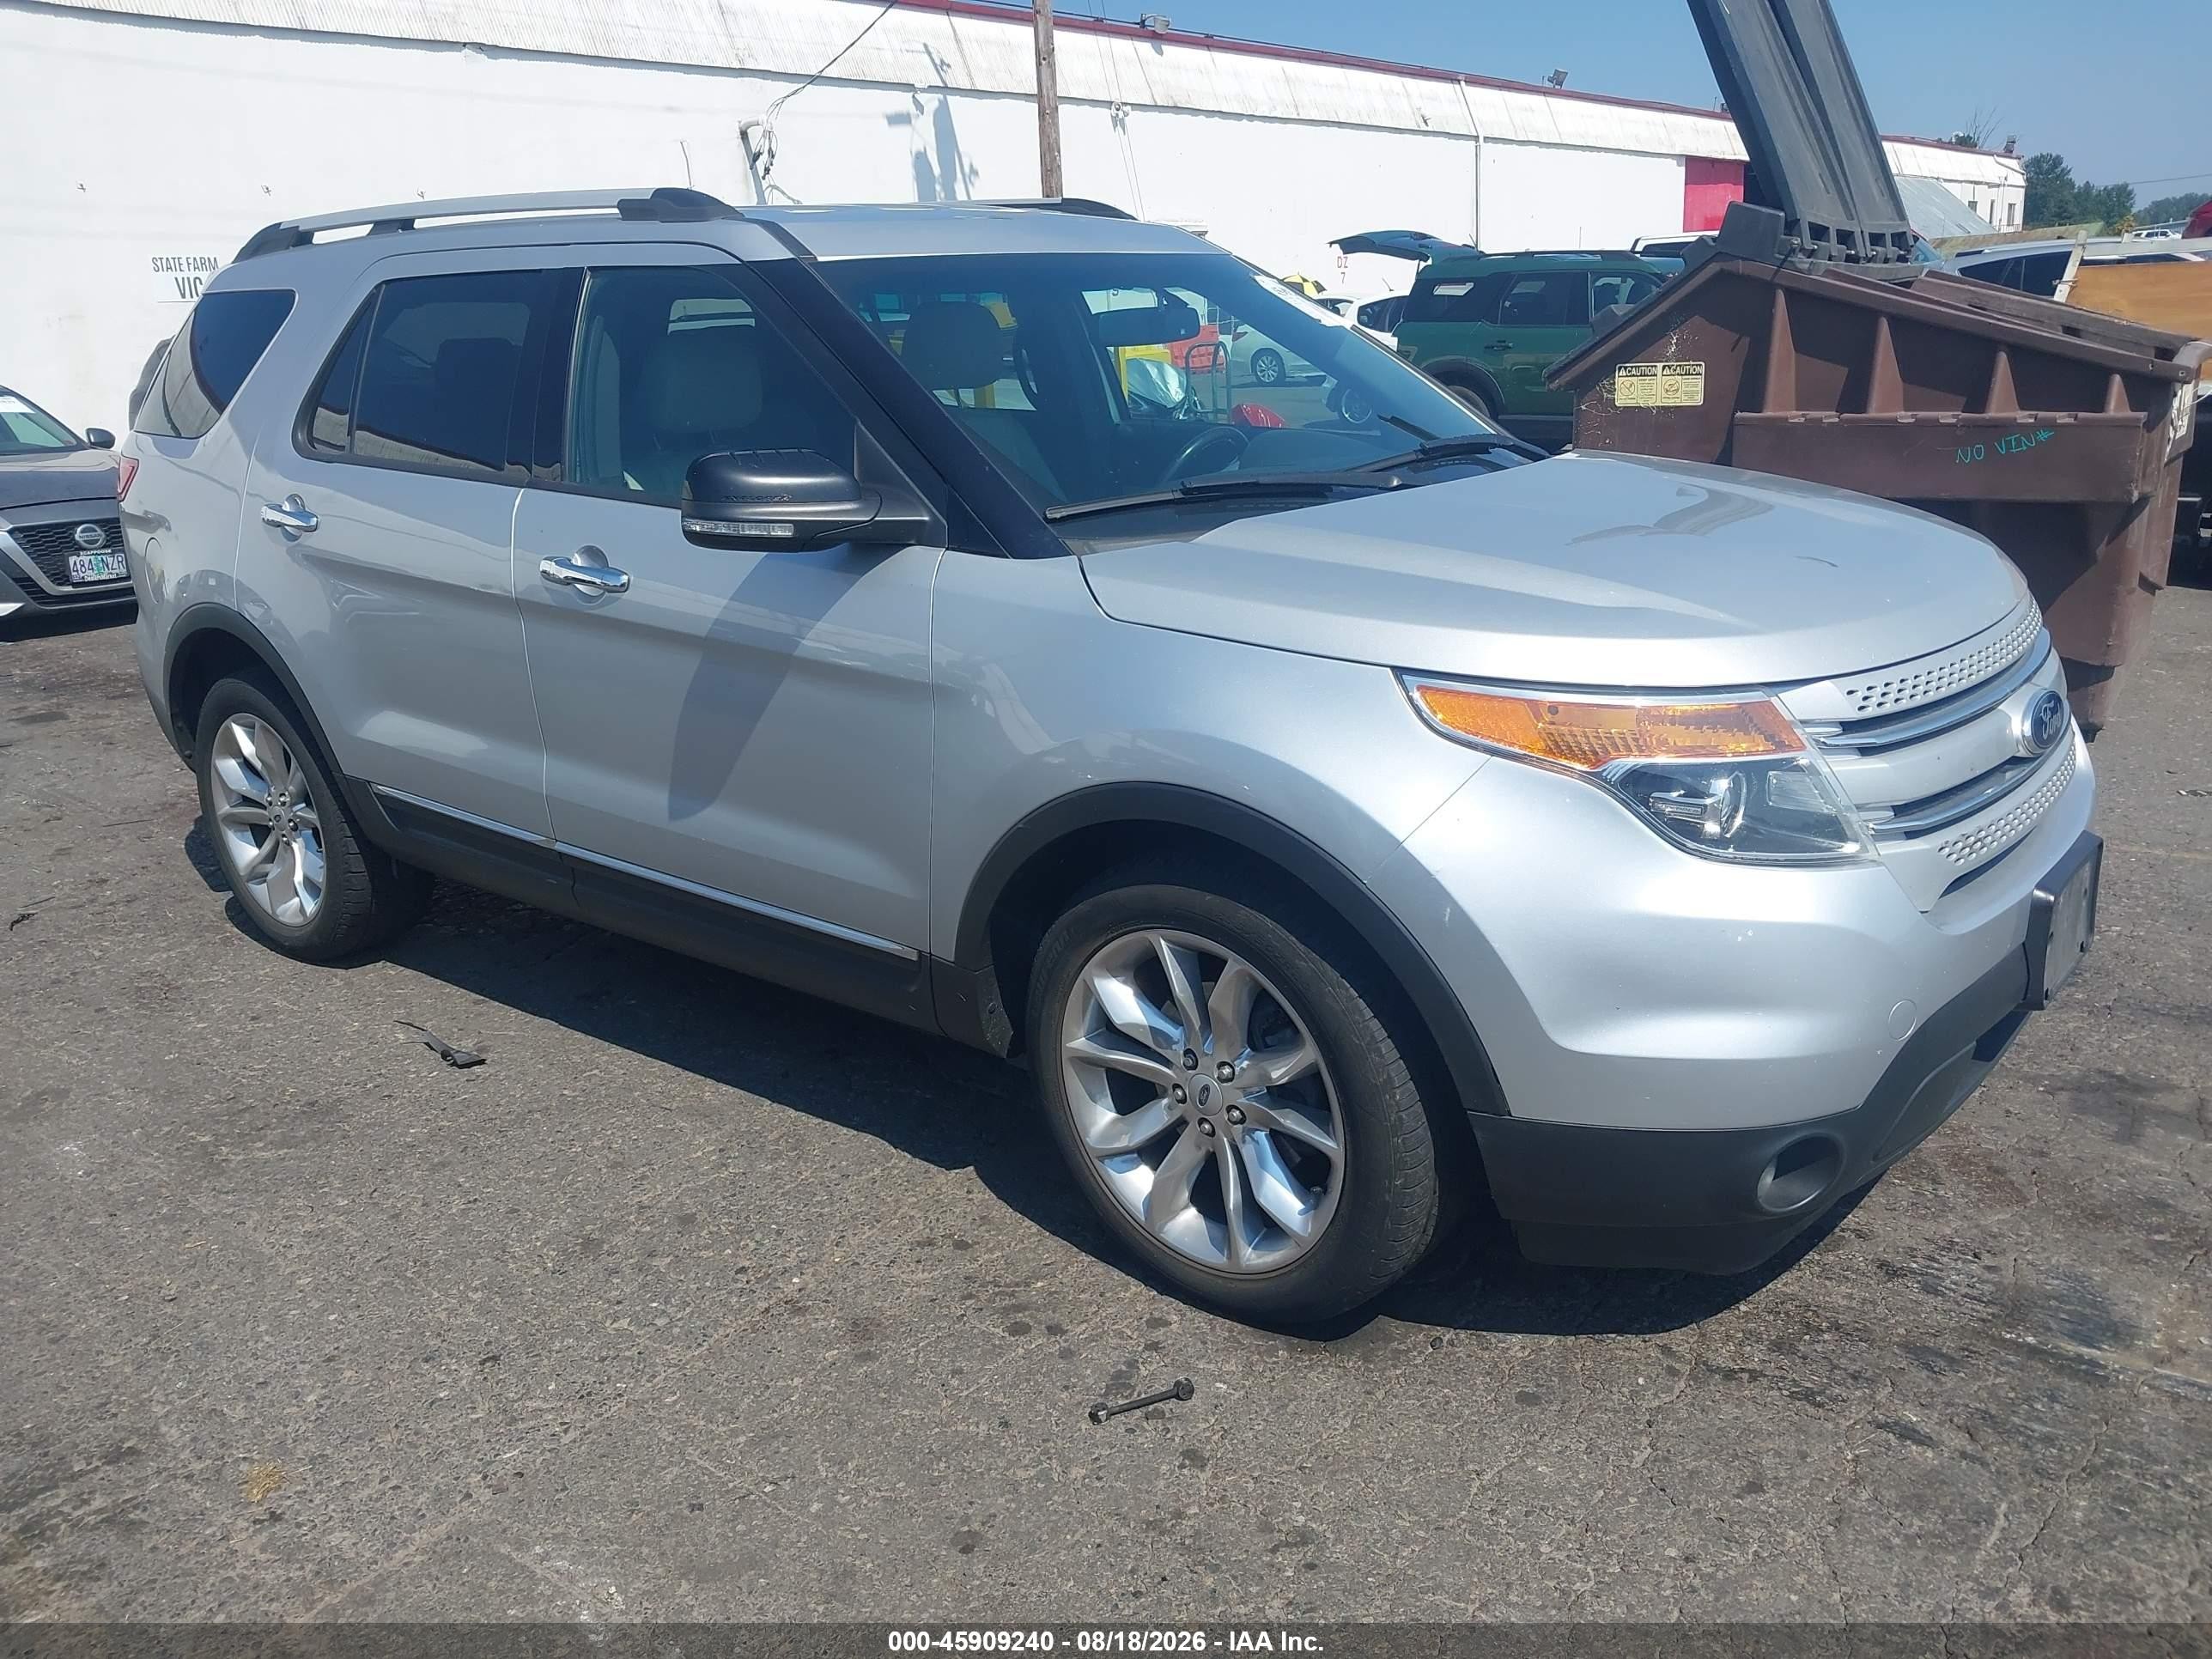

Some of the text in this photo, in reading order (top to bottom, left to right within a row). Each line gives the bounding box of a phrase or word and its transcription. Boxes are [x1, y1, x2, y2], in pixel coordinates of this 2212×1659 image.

[151, 256, 219, 272] STATE FARM
[1626, 366, 1657, 376] CAUTION
[1670, 364, 1703, 375] CAUTION
[1955, 444, 1984, 464] NO
[72, 555, 126, 576] 484 NZR
[2040, 700, 2062, 740] Ford
